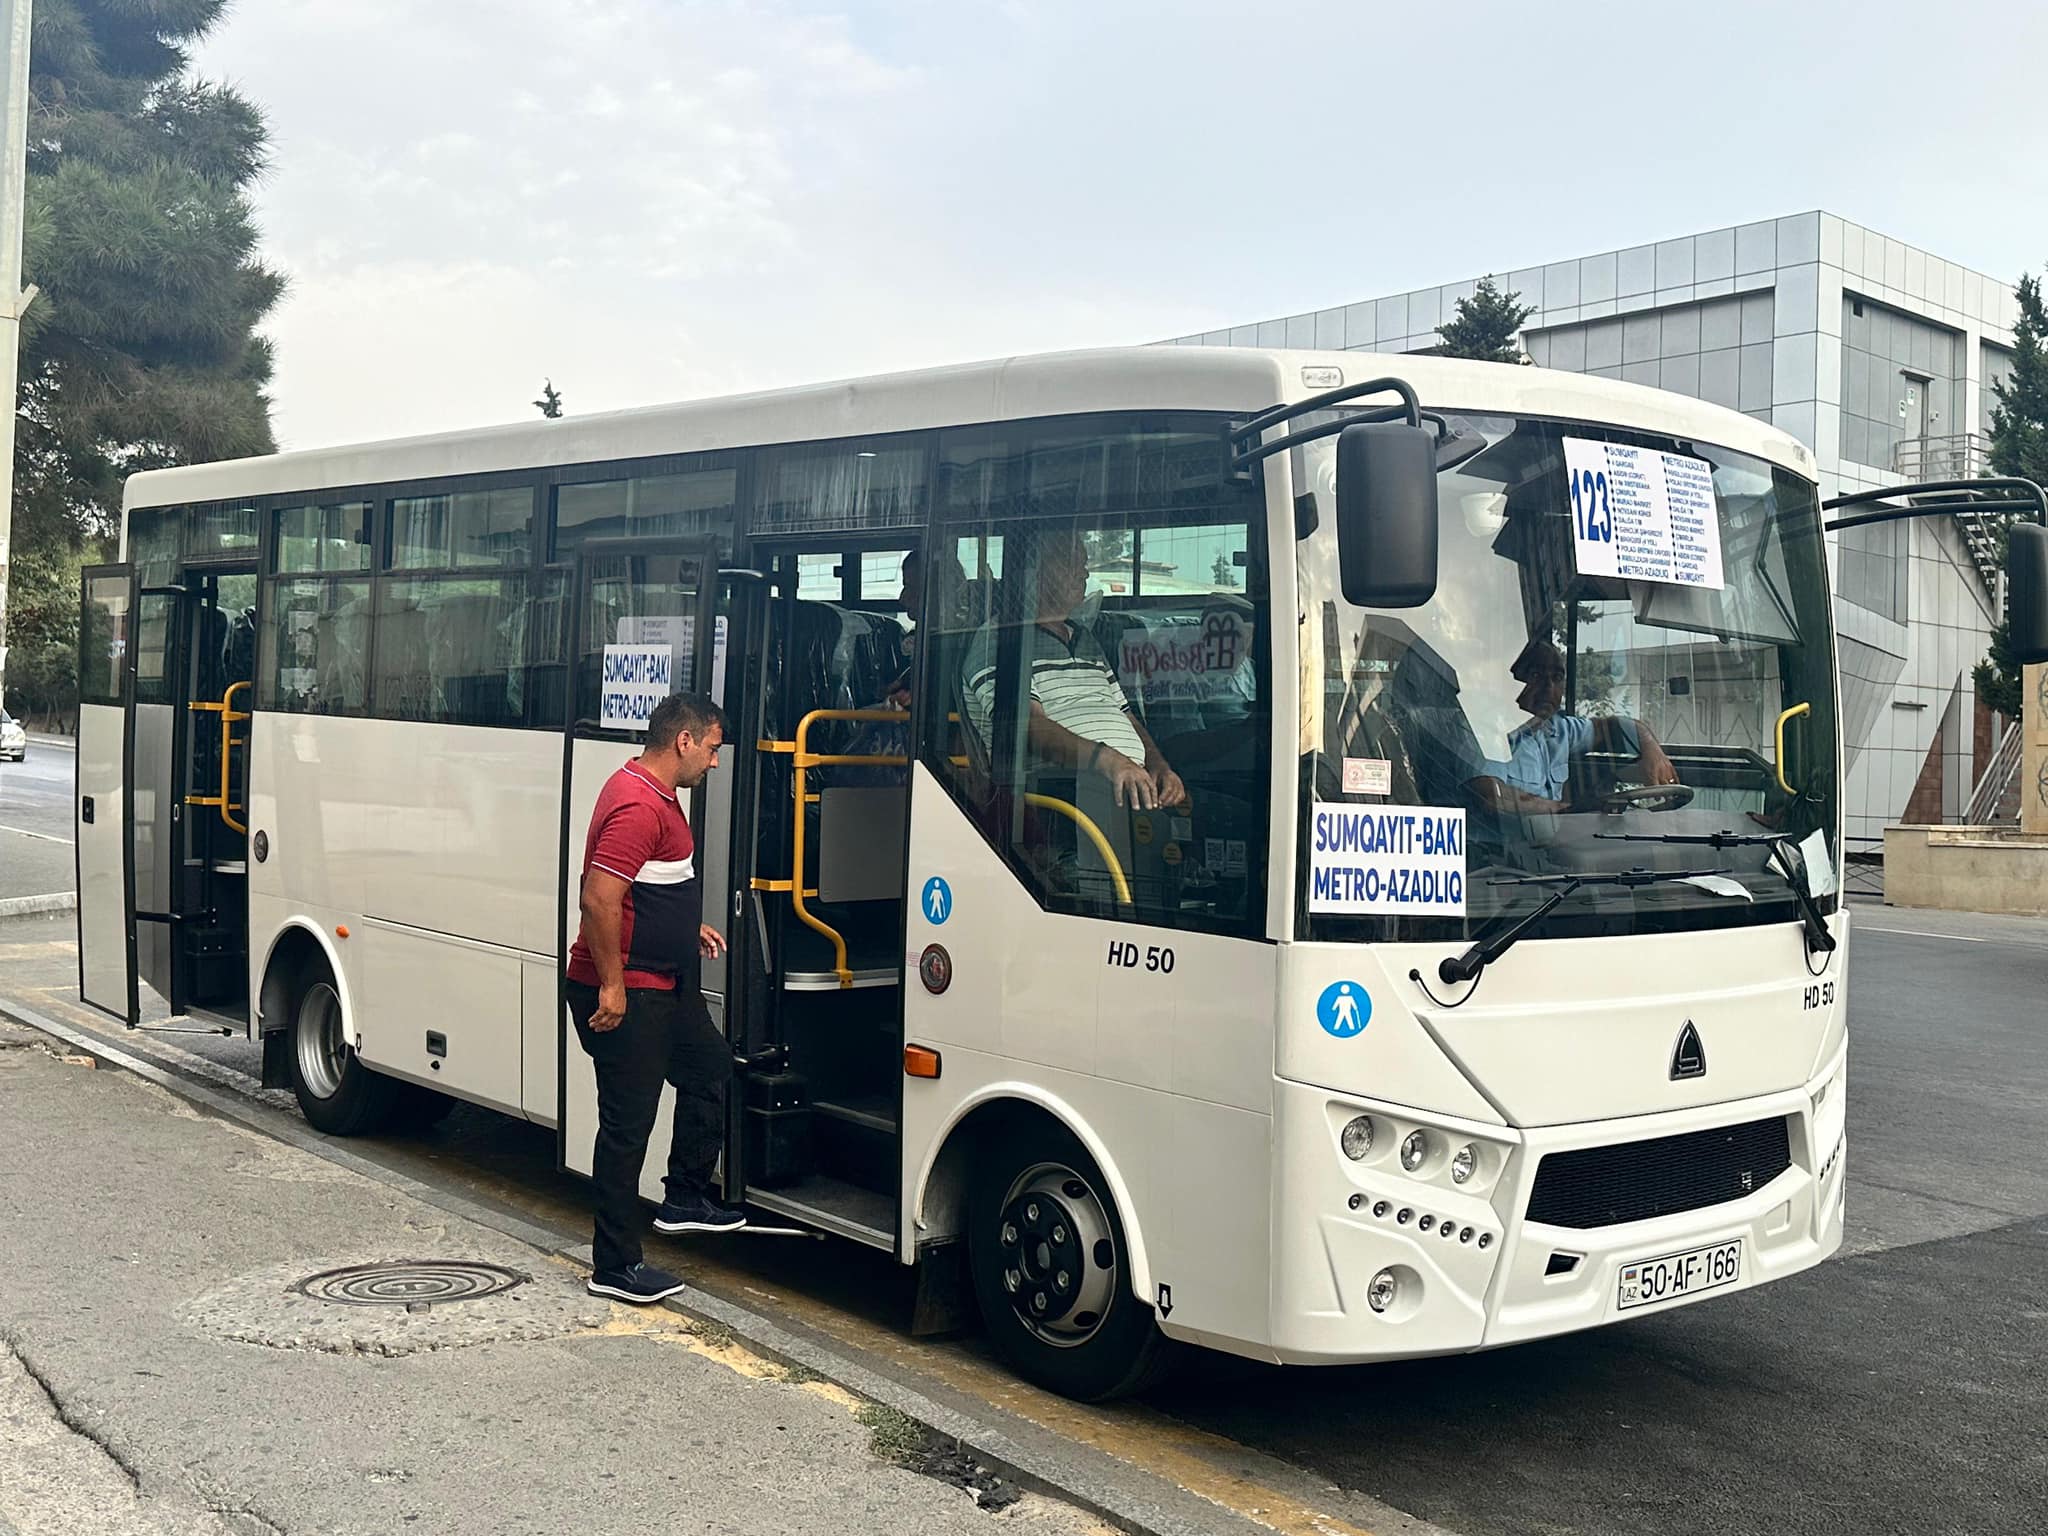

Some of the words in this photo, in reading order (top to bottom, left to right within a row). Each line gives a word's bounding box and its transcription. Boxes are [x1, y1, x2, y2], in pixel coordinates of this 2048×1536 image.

[1571, 468, 1612, 543] 123
[1623, 565, 1644, 576] METRO
[604, 654, 670, 684] SUMQAYIT-BAKI
[1315, 812, 1463, 856] SUMQAYIT-BAKI
[1314, 866, 1463, 904] METRO-AZADLIQ
[1107, 940, 1139, 968] HD
[1145, 945, 1175, 974] 50
[1804, 985, 1820, 1010] HD
[1822, 981, 1834, 1006] 50
[1626, 1287, 1637, 1298] AZ
